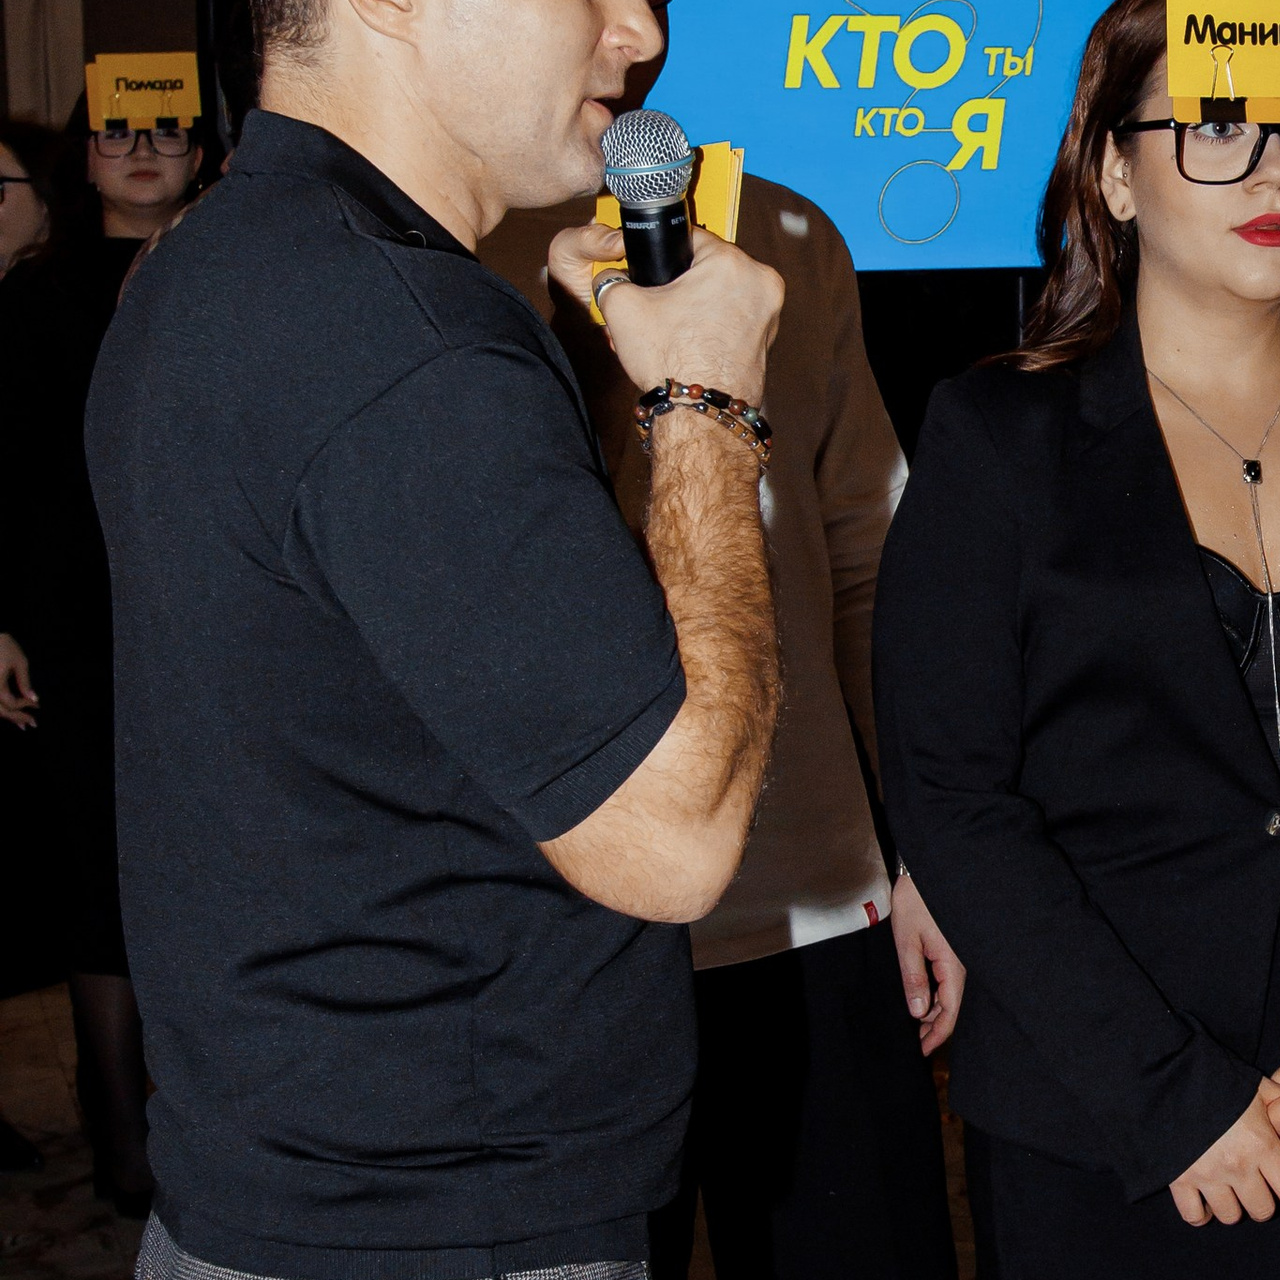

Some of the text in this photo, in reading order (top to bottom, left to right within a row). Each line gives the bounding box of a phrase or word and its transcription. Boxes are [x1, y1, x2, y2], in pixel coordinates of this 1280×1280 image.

[115, 76, 184, 93] Помада
[784, 13, 968, 90] КТО
[853, 96, 1006, 172] КТО Я
